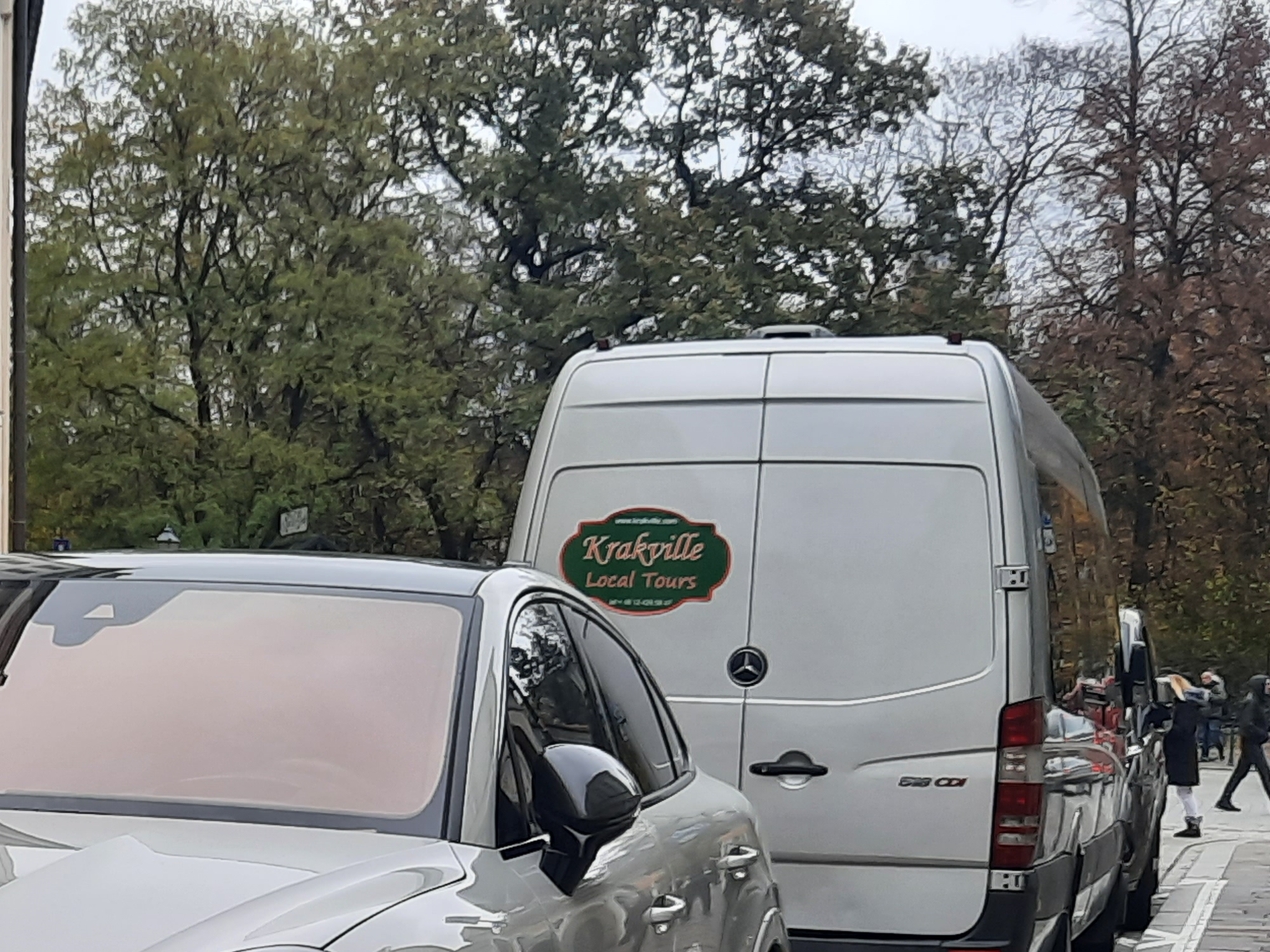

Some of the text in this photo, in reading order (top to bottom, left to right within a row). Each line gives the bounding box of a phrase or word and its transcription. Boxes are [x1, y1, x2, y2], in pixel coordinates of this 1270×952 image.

[583, 532, 705, 567] Krakville
[585, 570, 697, 590] Local Tours
